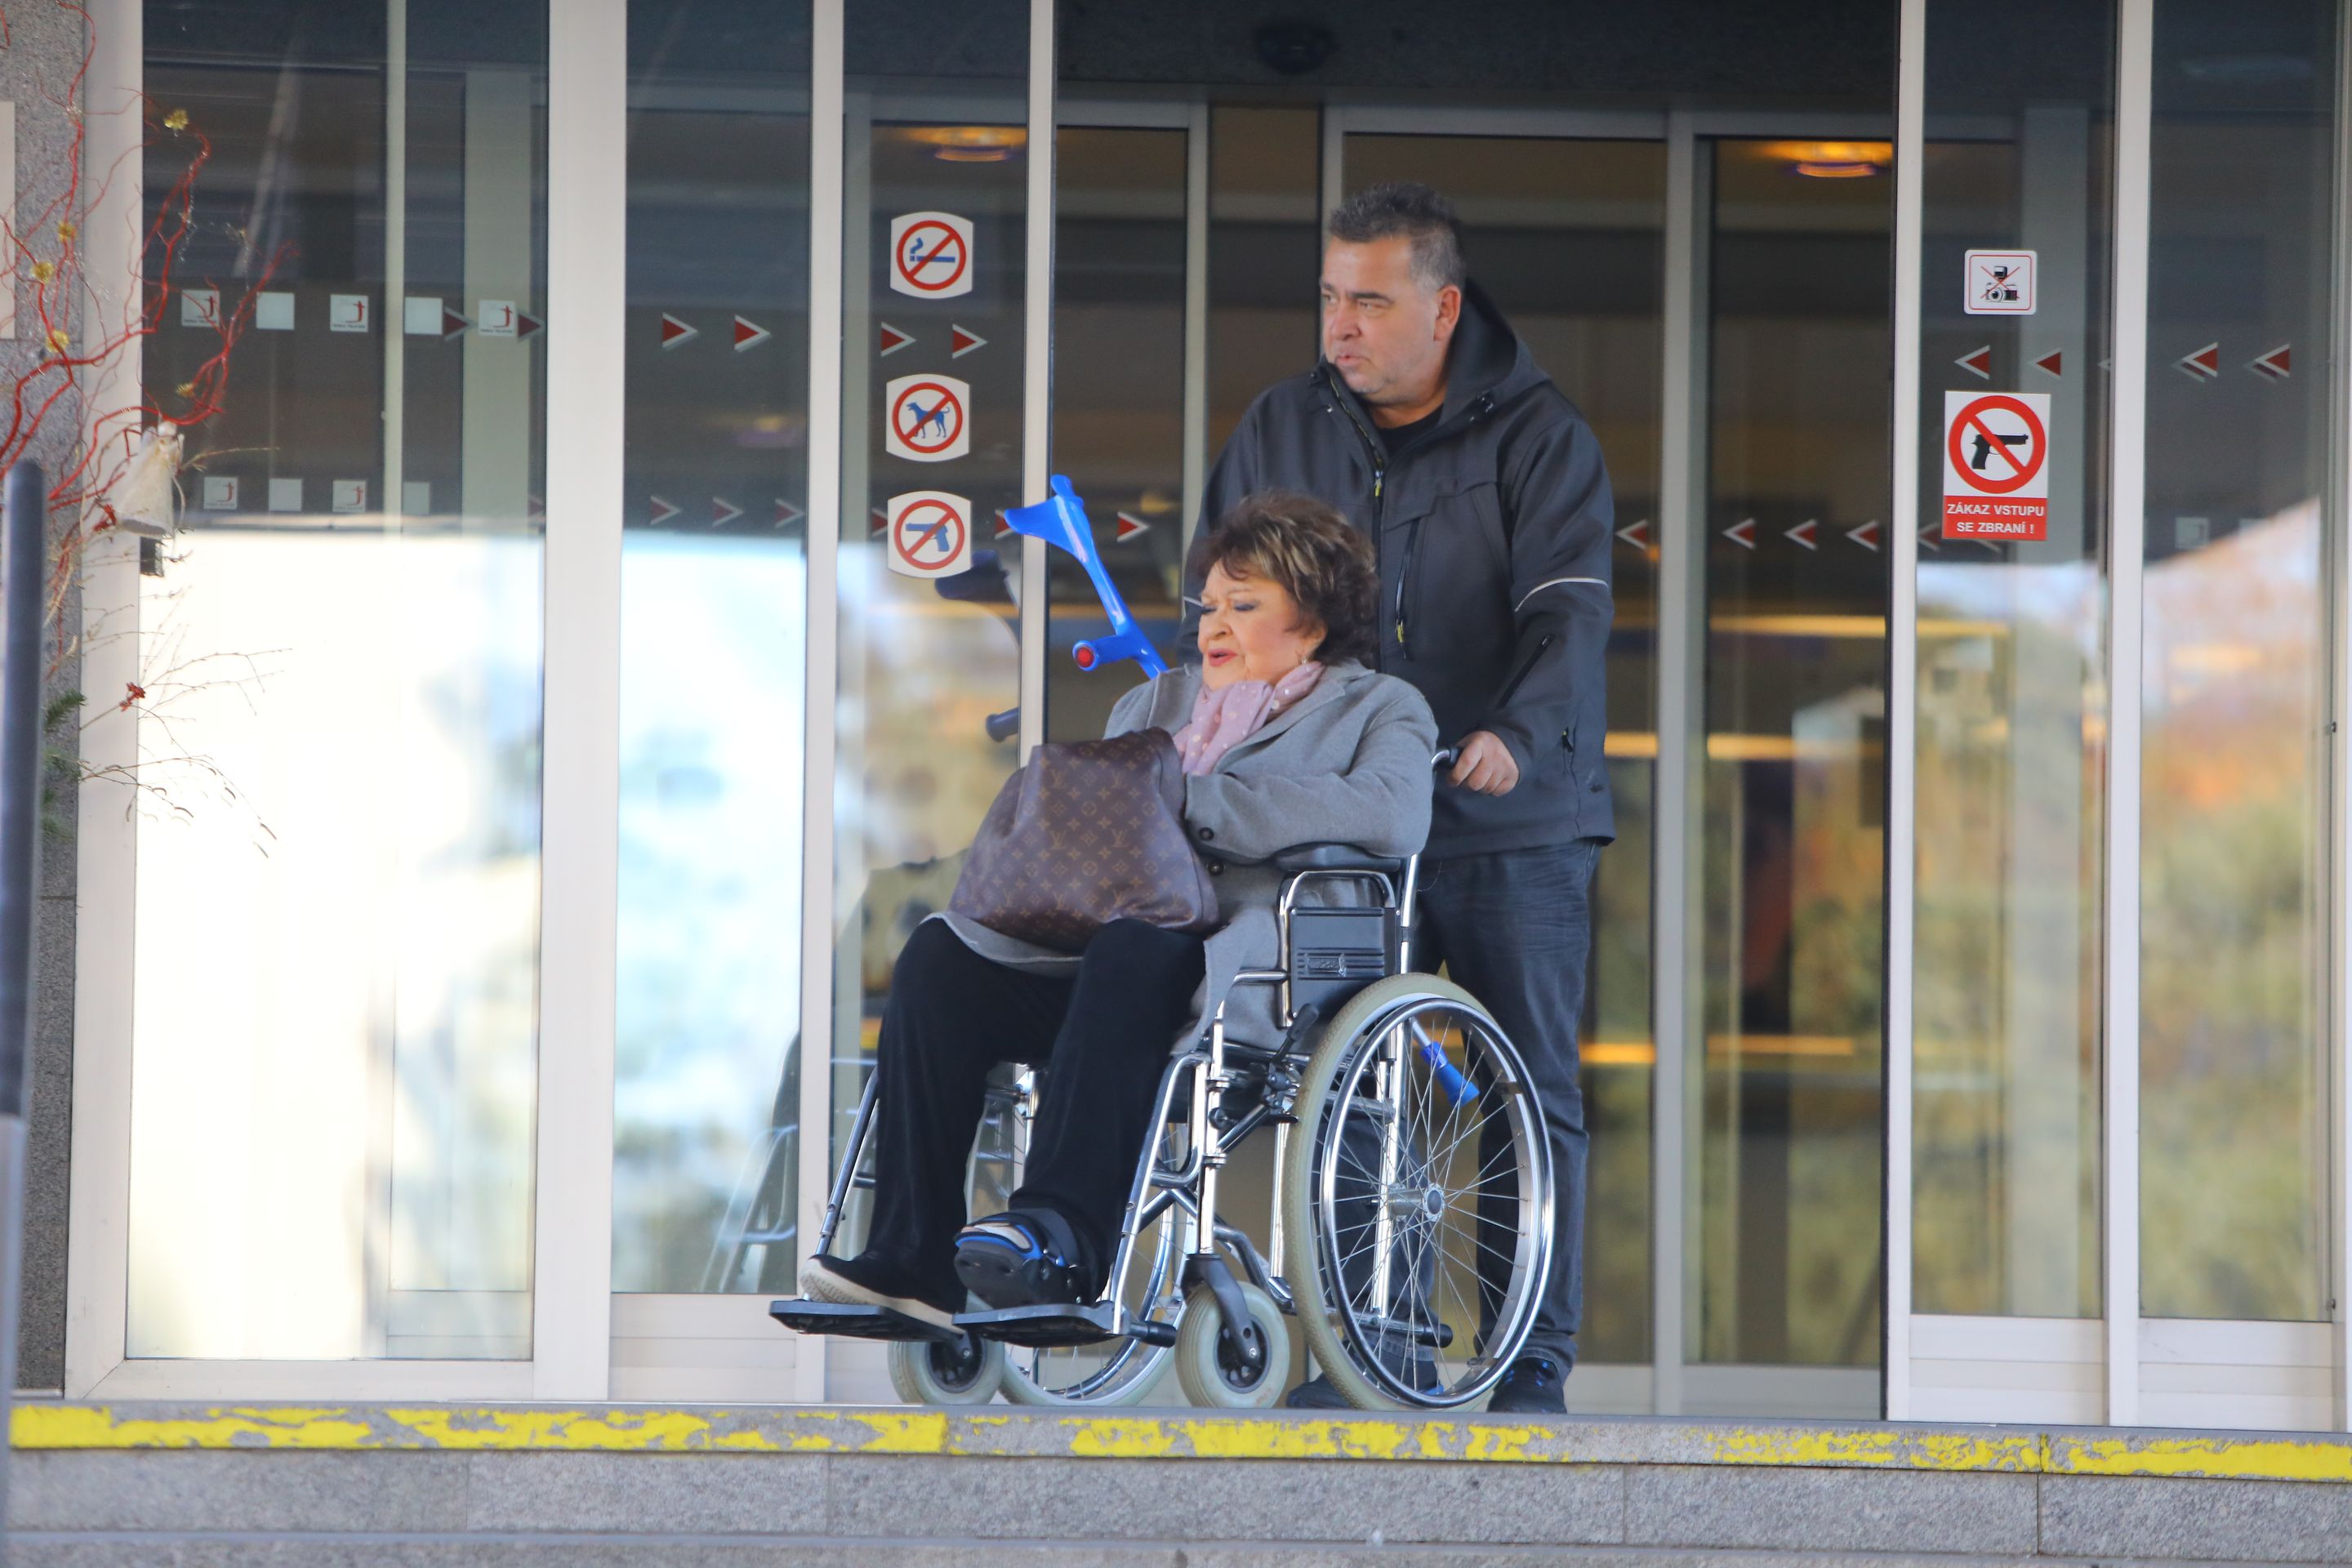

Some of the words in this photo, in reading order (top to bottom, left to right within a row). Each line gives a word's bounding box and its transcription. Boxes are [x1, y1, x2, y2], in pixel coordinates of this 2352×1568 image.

[1947, 502, 1990, 514] ZÁKAZ
[1993, 505, 2044, 516] VSTUPU
[1957, 522, 1974, 532] SE
[1977, 521, 2026, 533] ZBRANÍ
